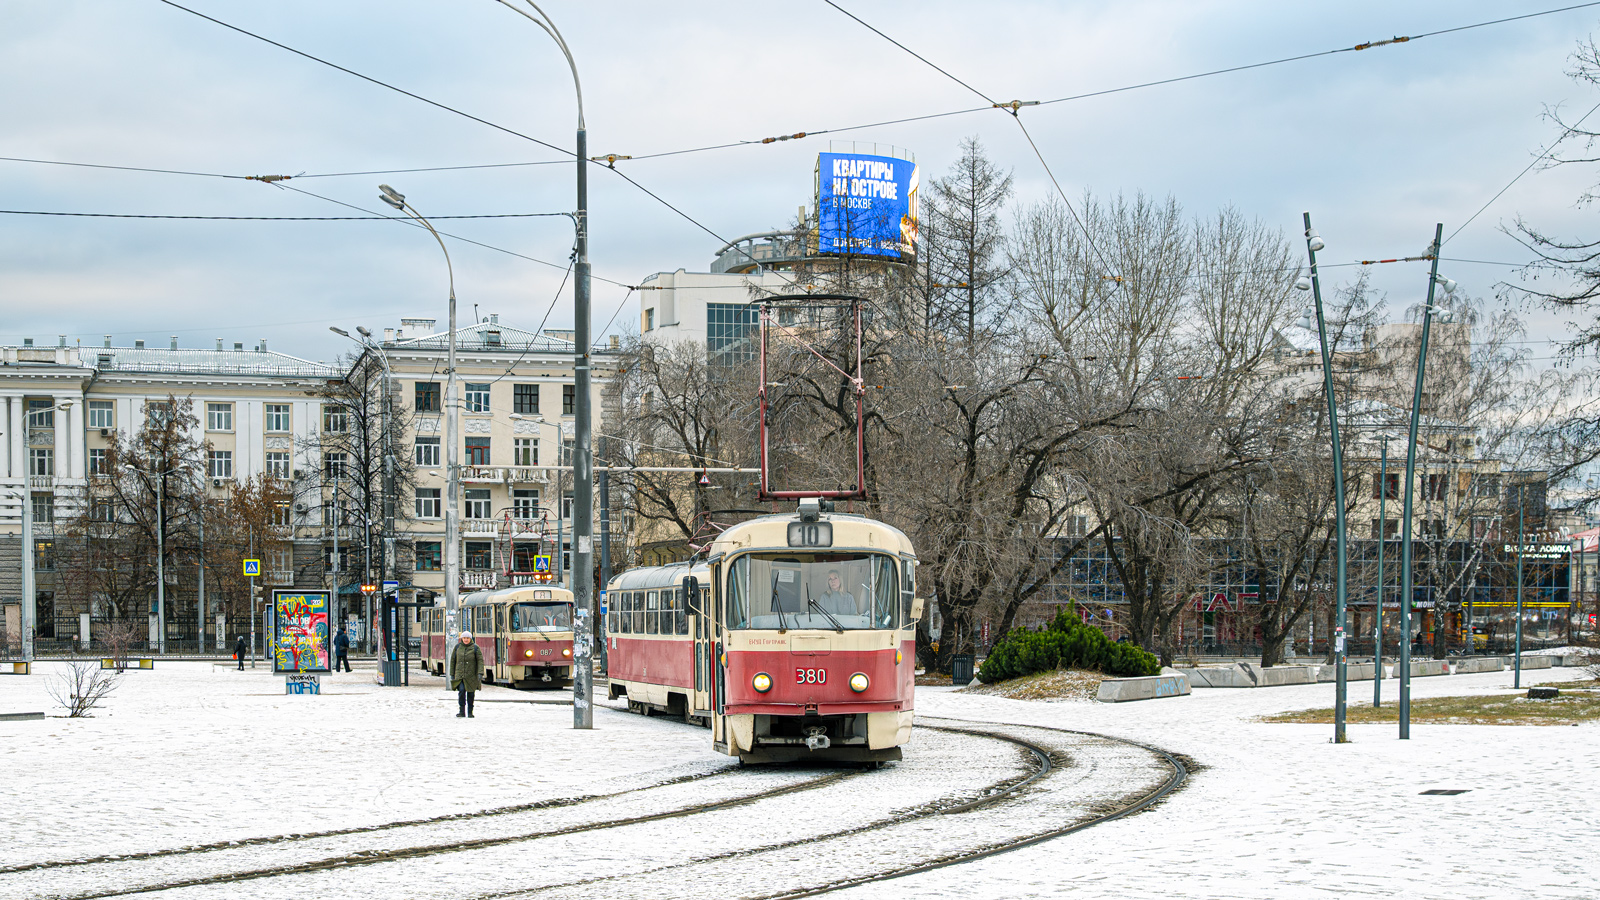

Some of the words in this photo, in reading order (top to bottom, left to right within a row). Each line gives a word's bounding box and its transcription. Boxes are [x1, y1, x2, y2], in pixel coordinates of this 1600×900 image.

[833, 159, 894, 181] КВАРТИРЫ
[833, 178, 849, 196] НА
[851, 179, 898, 200] ОСТРОВЕ
[800, 525, 819, 546] 10
[1540, 544, 1572, 553] ЛОЖКА
[540, 648, 553, 656] 087
[796, 668, 827, 685] 380
